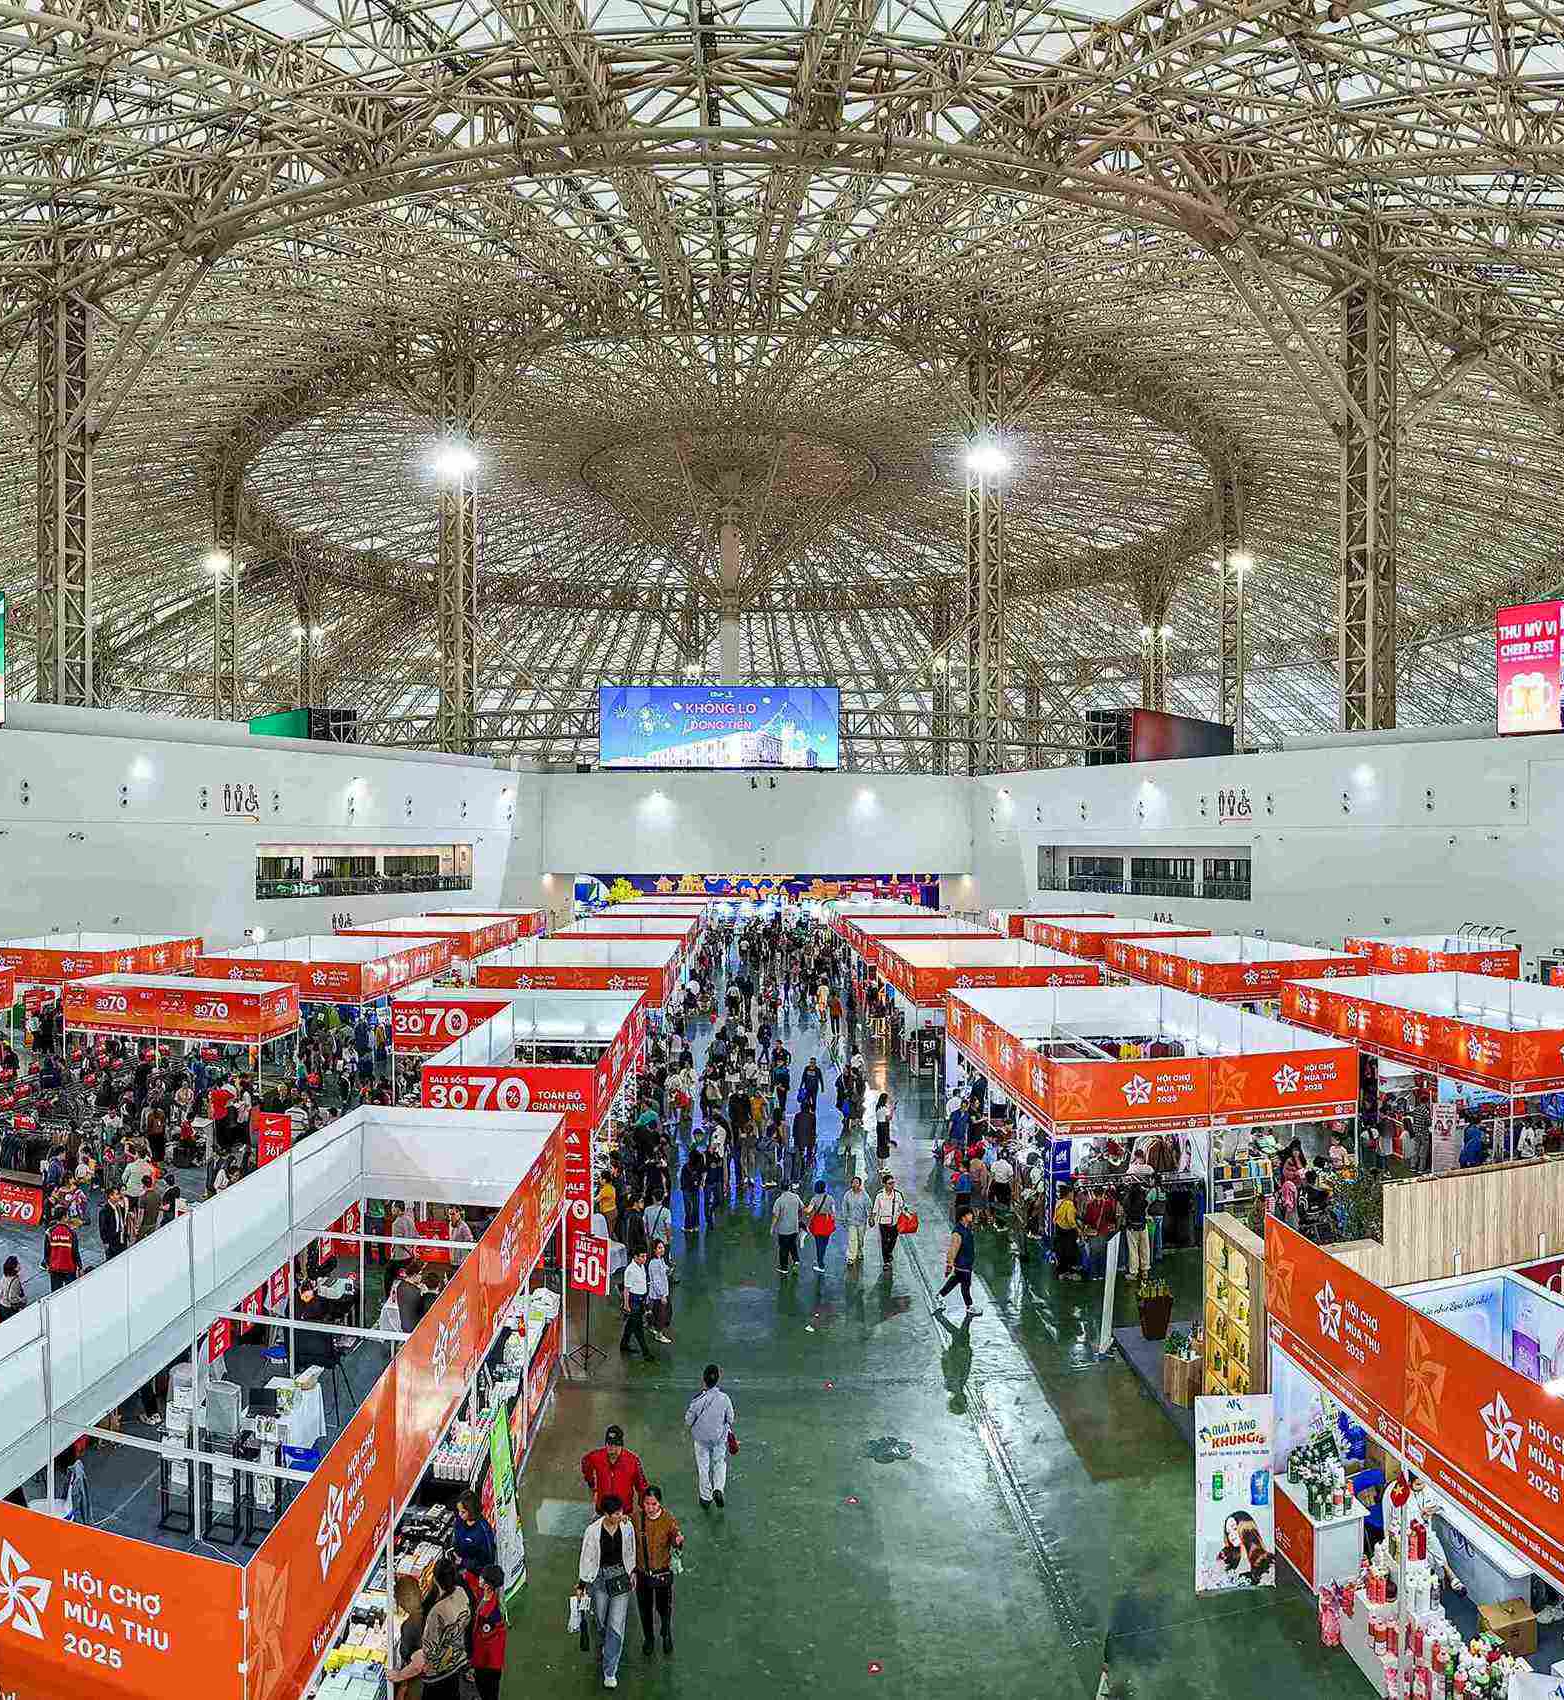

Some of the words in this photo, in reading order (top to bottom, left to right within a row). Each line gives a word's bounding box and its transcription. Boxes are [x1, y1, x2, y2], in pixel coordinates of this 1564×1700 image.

[1176, 1084, 1194, 1092] THU
[1345, 1299, 1360, 1321] HỘI
[1360, 1310, 1380, 1334] CHỢ
[1345, 1339, 1365, 1364] 2025
[1363, 1331, 1381, 1354] THU
[1528, 1418, 1550, 1445] HỘI
[1528, 1443, 1556, 1475] MÙA
[1527, 1469, 1559, 1503] 2025
[63, 1568, 103, 1600] HỘI
[108, 1584, 163, 1620] CHỢ
[64, 1598, 115, 1635] MÙA
[120, 1617, 170, 1652] THU
[63, 1631, 123, 1669] 2025
